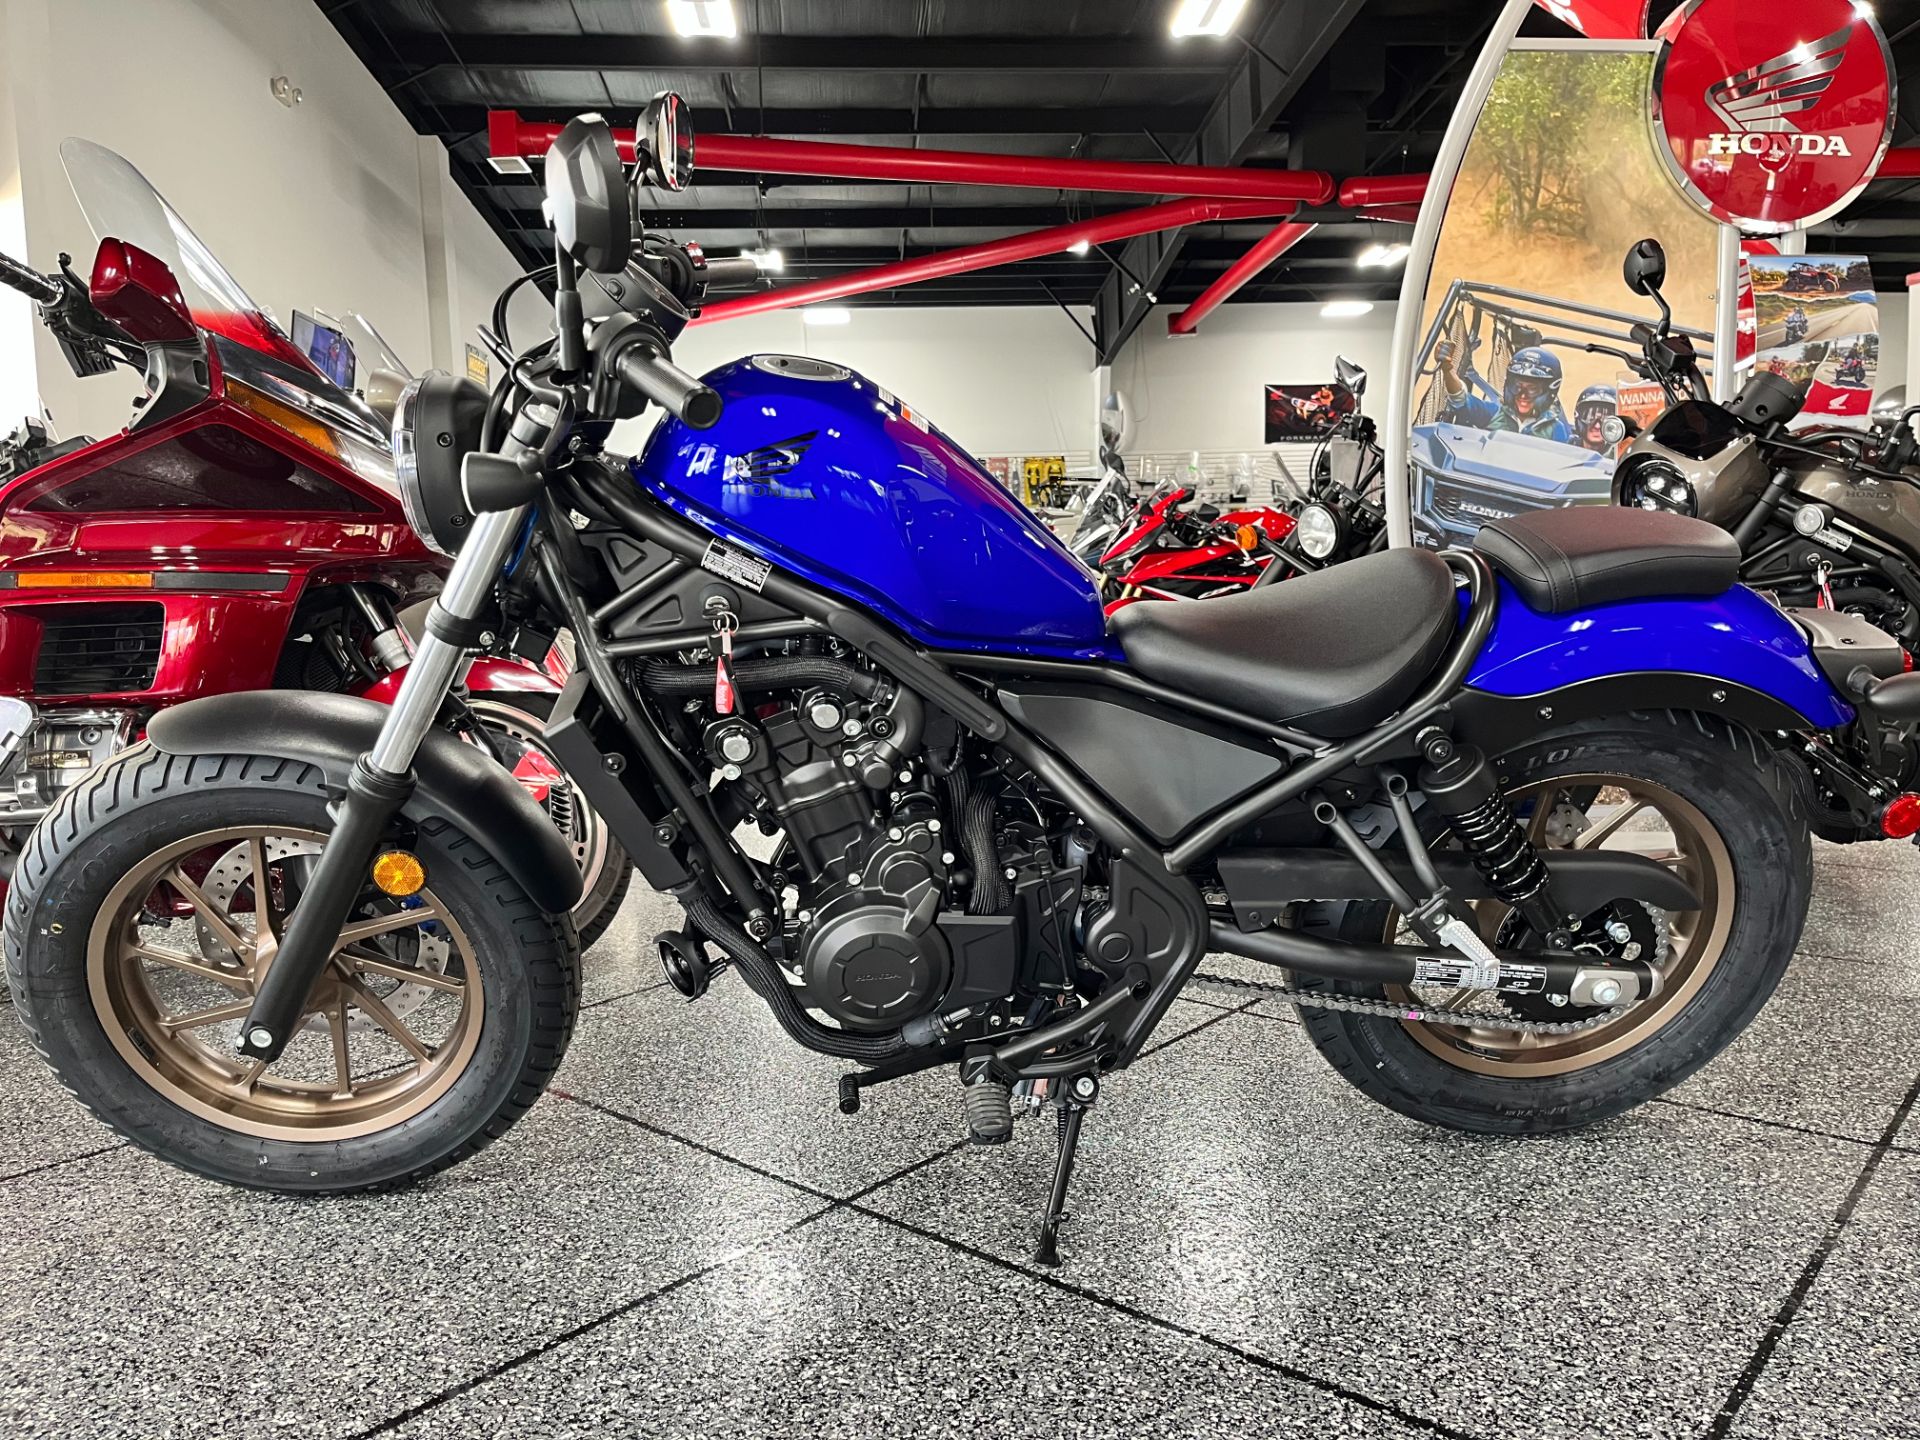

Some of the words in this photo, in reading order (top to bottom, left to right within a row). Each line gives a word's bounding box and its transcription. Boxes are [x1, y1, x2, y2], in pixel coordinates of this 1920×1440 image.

[1708, 133, 1852, 157] HONDA
[1619, 390, 1665, 405] WANNA
[1846, 490, 1894, 499] HONDA
[1458, 501, 1515, 519] HOND
